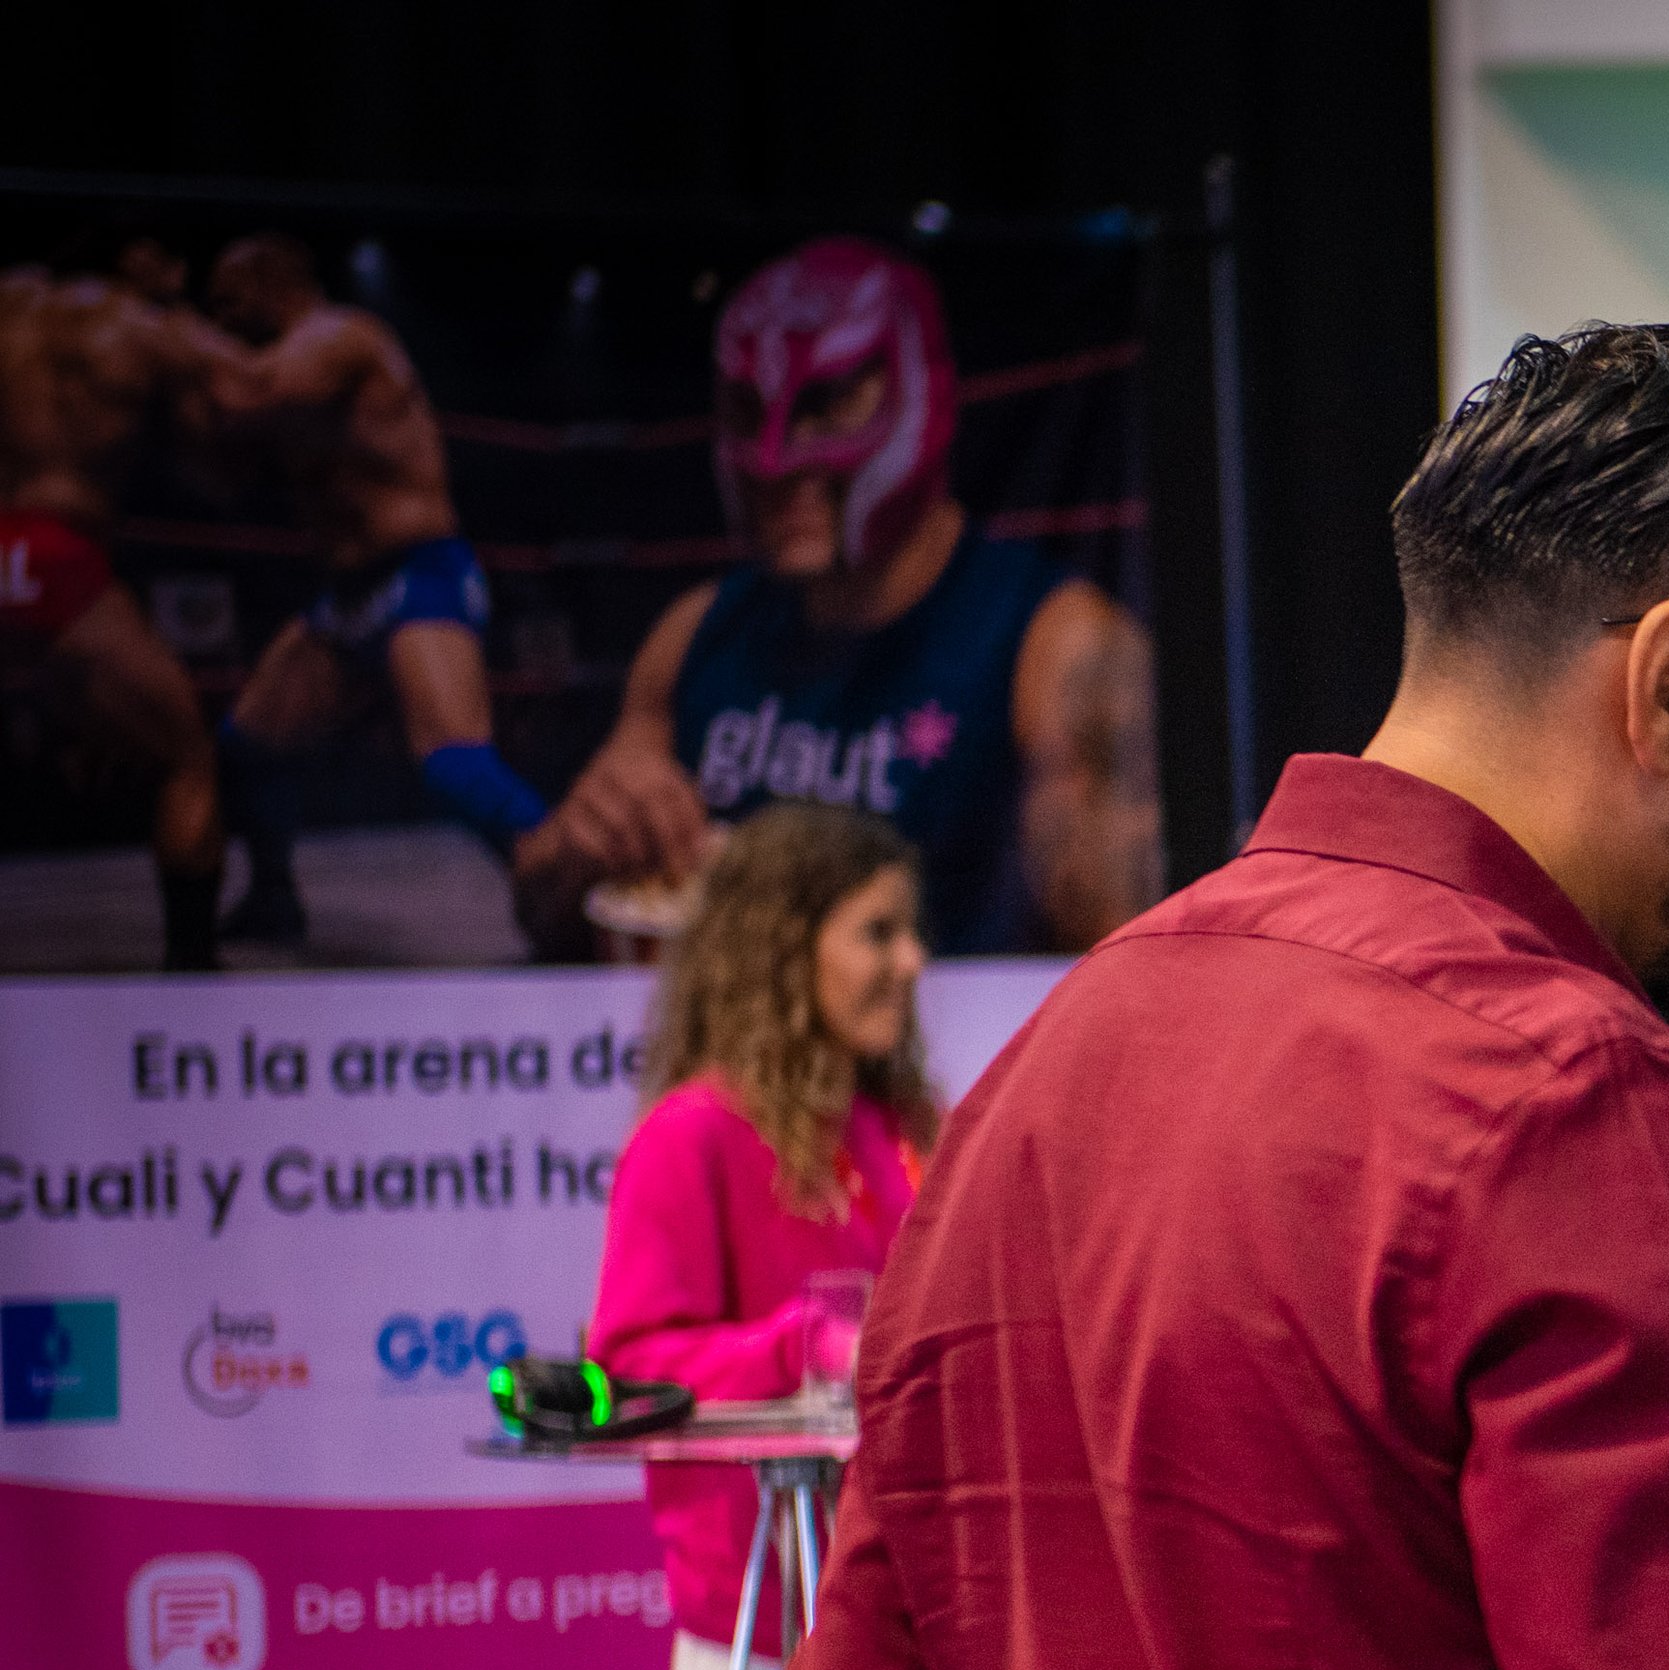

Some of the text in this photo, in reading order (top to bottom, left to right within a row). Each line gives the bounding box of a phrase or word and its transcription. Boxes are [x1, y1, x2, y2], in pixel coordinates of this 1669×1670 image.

[700, 694, 900, 812] glaut
[131, 1030, 219, 1100] En
[240, 1026, 309, 1098] la
[331, 1034, 550, 1096] arena
[198, 1158, 242, 1237] y
[264, 1134, 515, 1216] Cuanti
[295, 1568, 673, 1635] De brief a preg
